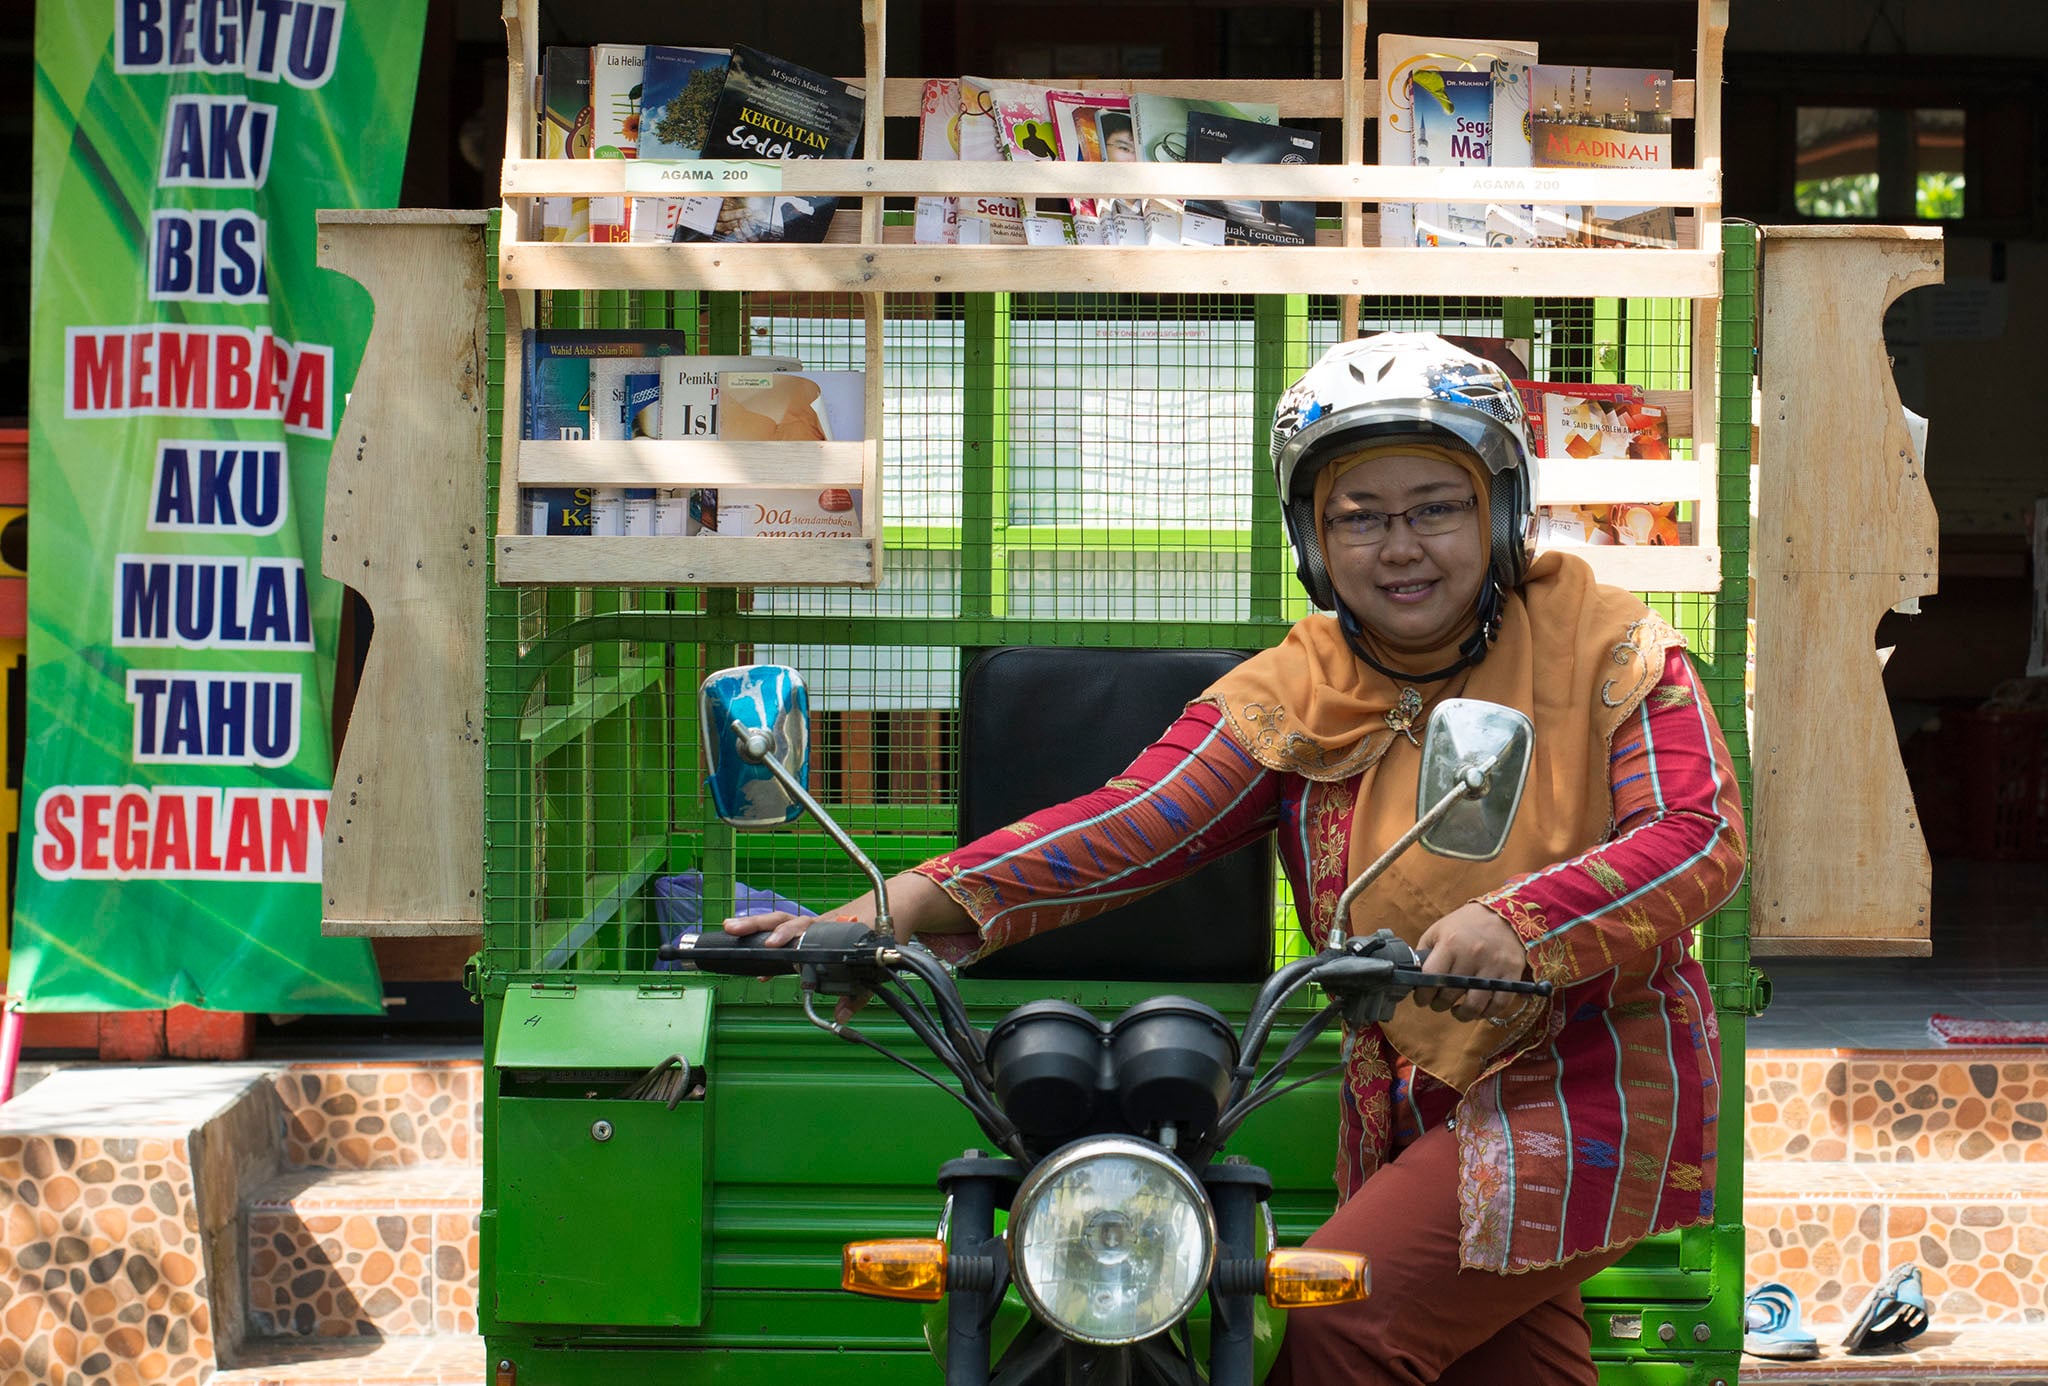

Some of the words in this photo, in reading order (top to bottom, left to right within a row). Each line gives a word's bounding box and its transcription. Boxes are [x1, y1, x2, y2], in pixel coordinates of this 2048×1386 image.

[608, 55, 619, 66] Lia
[771, 69, 780, 77] M
[801, 80, 829, 95] Maskur
[740, 107, 829, 150] KEKUATAN
[1207, 129, 1228, 139] Arifah
[726, 125, 824, 159] Sedek
[1547, 132, 1659, 162] MADINAH
[601, 151, 620, 159] SMART
[661, 170, 714, 181] AGAMA
[723, 170, 748, 181] 200
[1473, 180, 1526, 190] AGAMA
[1535, 180, 1561, 190] 200
[1249, 228, 1305, 245] Fenomena
[155, 218, 268, 296] BIS
[550, 345, 573, 355] Wahid
[574, 345, 596, 355] Abdus
[598, 345, 618, 355] Salam
[619, 344, 633, 355] Bali
[679, 371, 718, 385] Pemiki
[155, 448, 280, 527] AKU
[793, 515, 853, 528] Mendambakan
[121, 562, 311, 642] MULAI
[134, 678, 293, 759] TAHU
